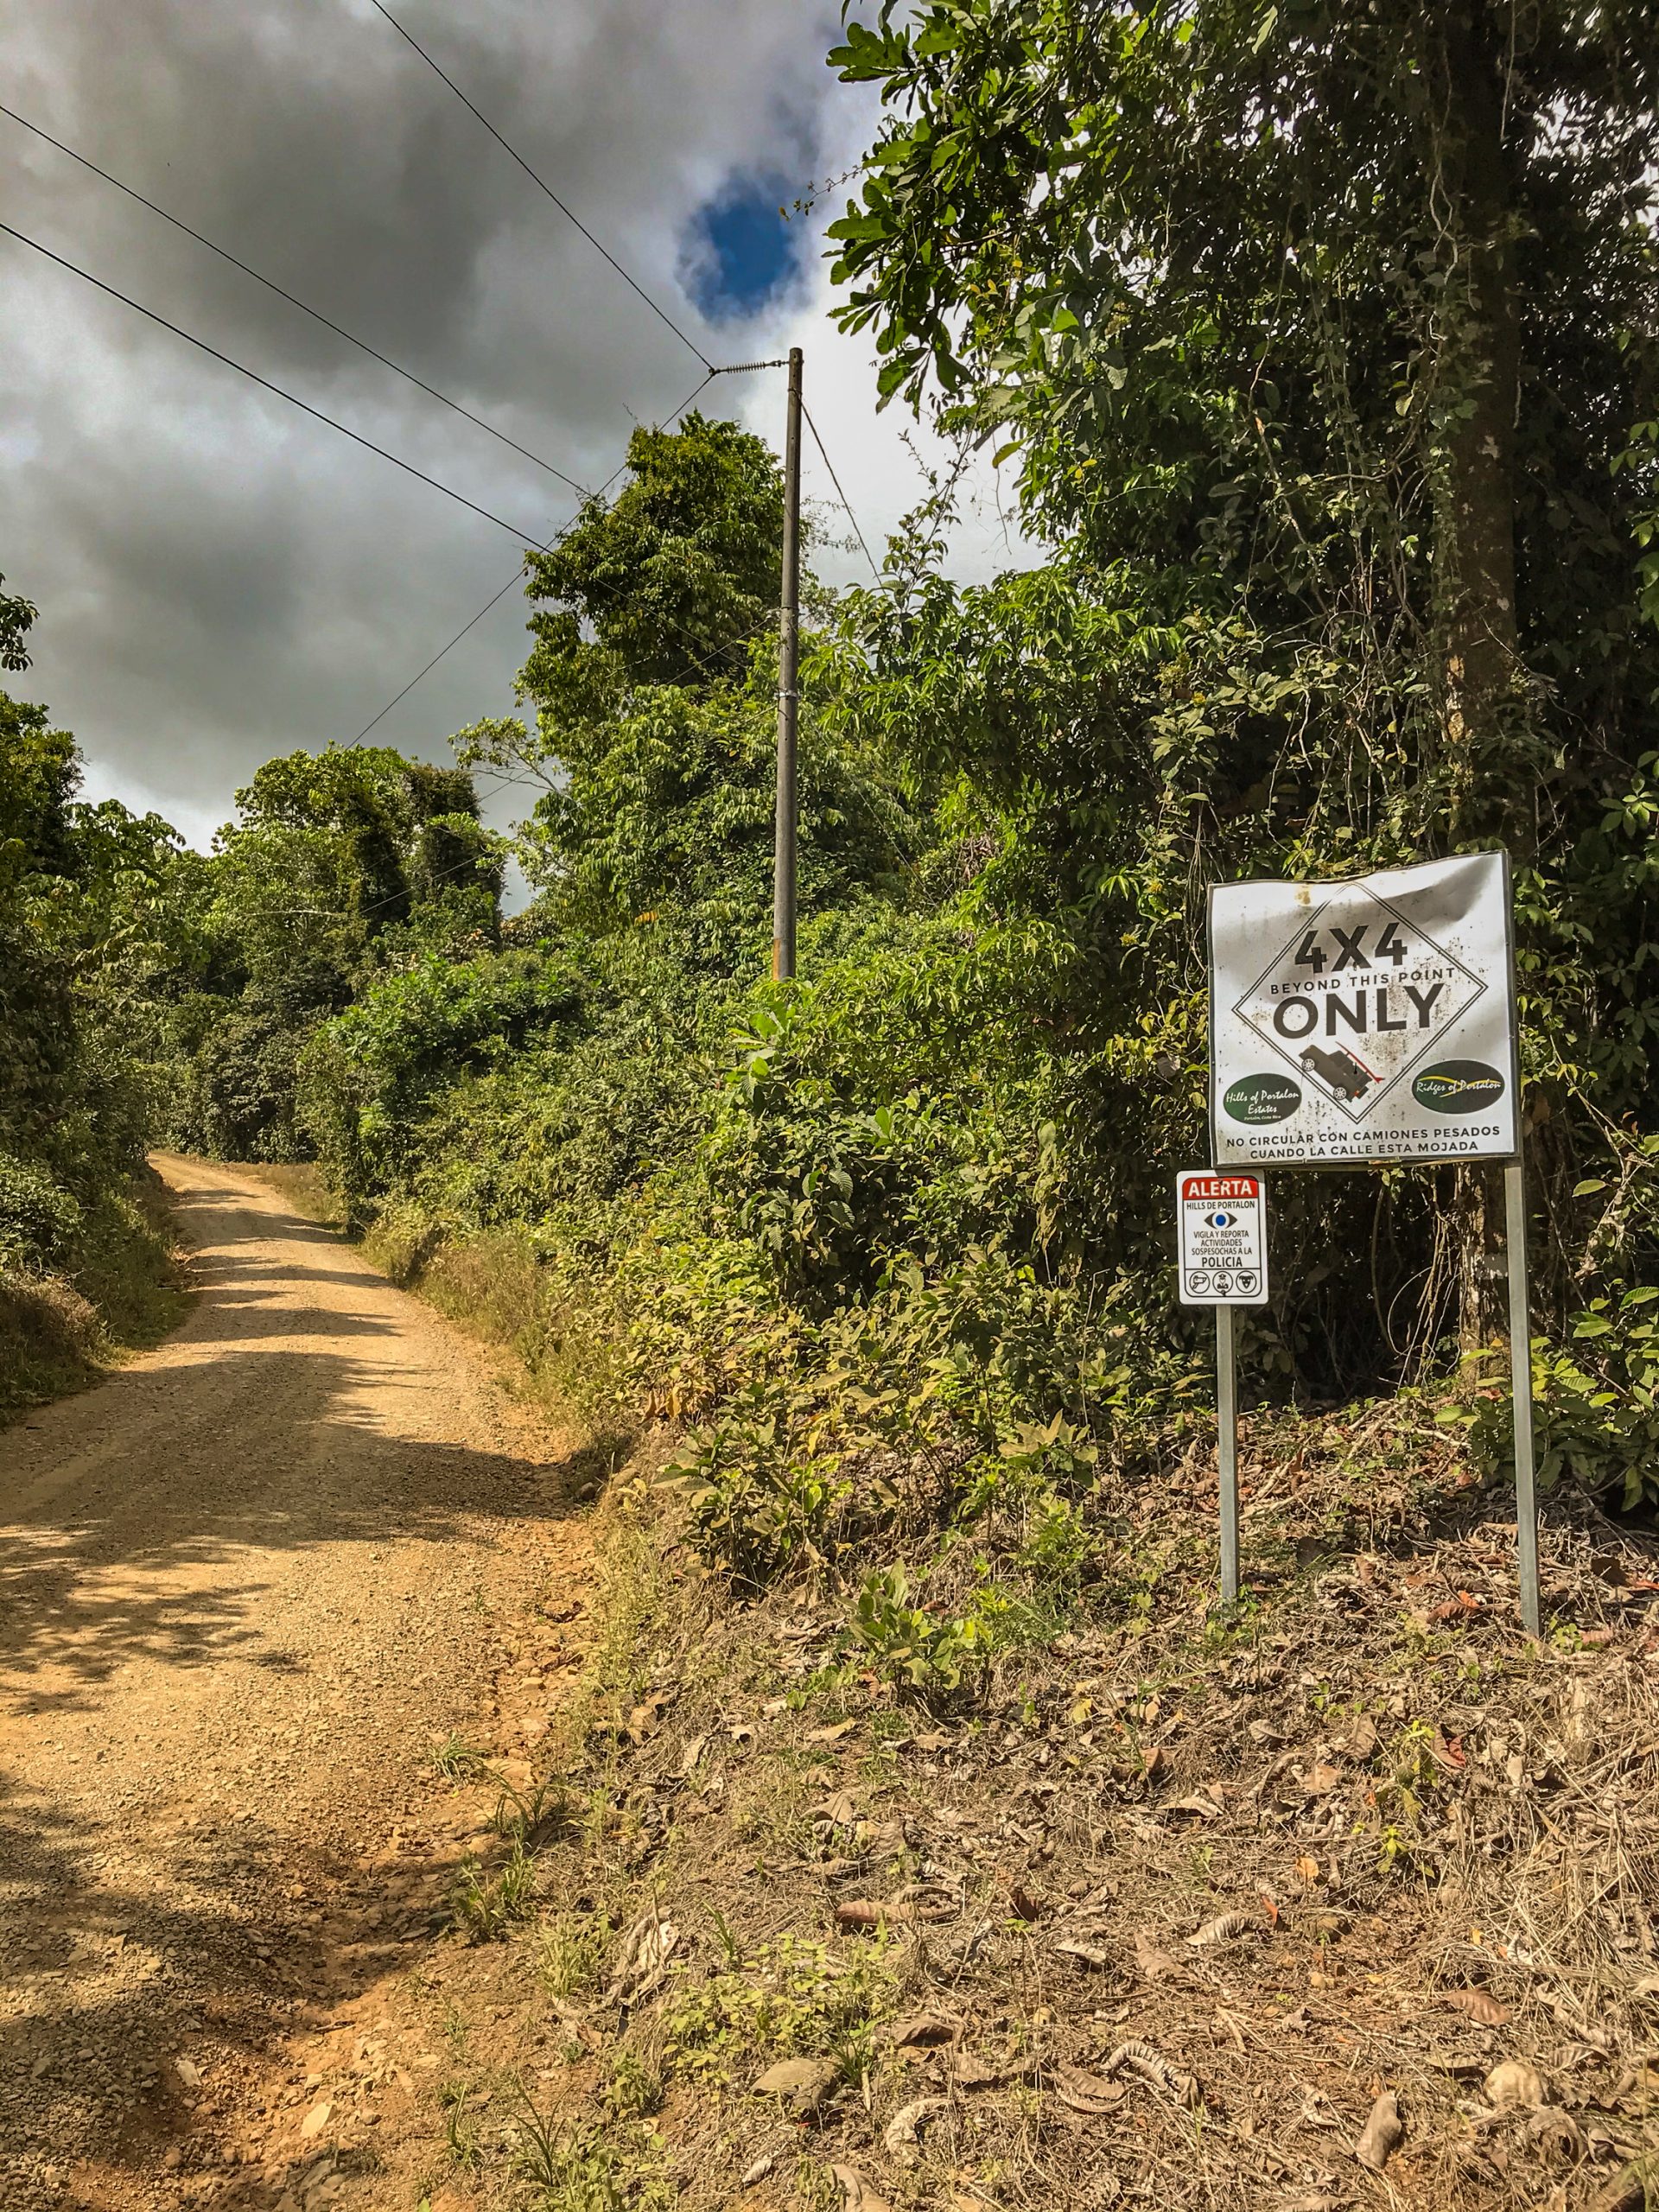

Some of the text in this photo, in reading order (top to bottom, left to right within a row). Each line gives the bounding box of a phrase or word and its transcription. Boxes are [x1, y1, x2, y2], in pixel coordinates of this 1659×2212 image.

[1294, 922, 1408, 974] 4X4
[1270, 967, 1455, 995] BEYOND THIS POINT
[1273, 983, 1445, 1039] ONLY
[1416, 1082, 1446, 1095] Ridges
[1448, 1080, 1458, 1094] of
[1226, 1091, 1248, 1103] Hills
[1250, 1091, 1259, 1104] of
[1248, 1104, 1277, 1114] Estates
[1227, 1126, 1500, 1147] NO CIRCULAR CON CAMIONES PESADOS
[1250, 1141, 1478, 1160] CUANDO LA CALLE ESTA MOJADA
[1188, 1180, 1252, 1197] ALERTA
[1202, 1257, 1243, 1268] POLICIA
